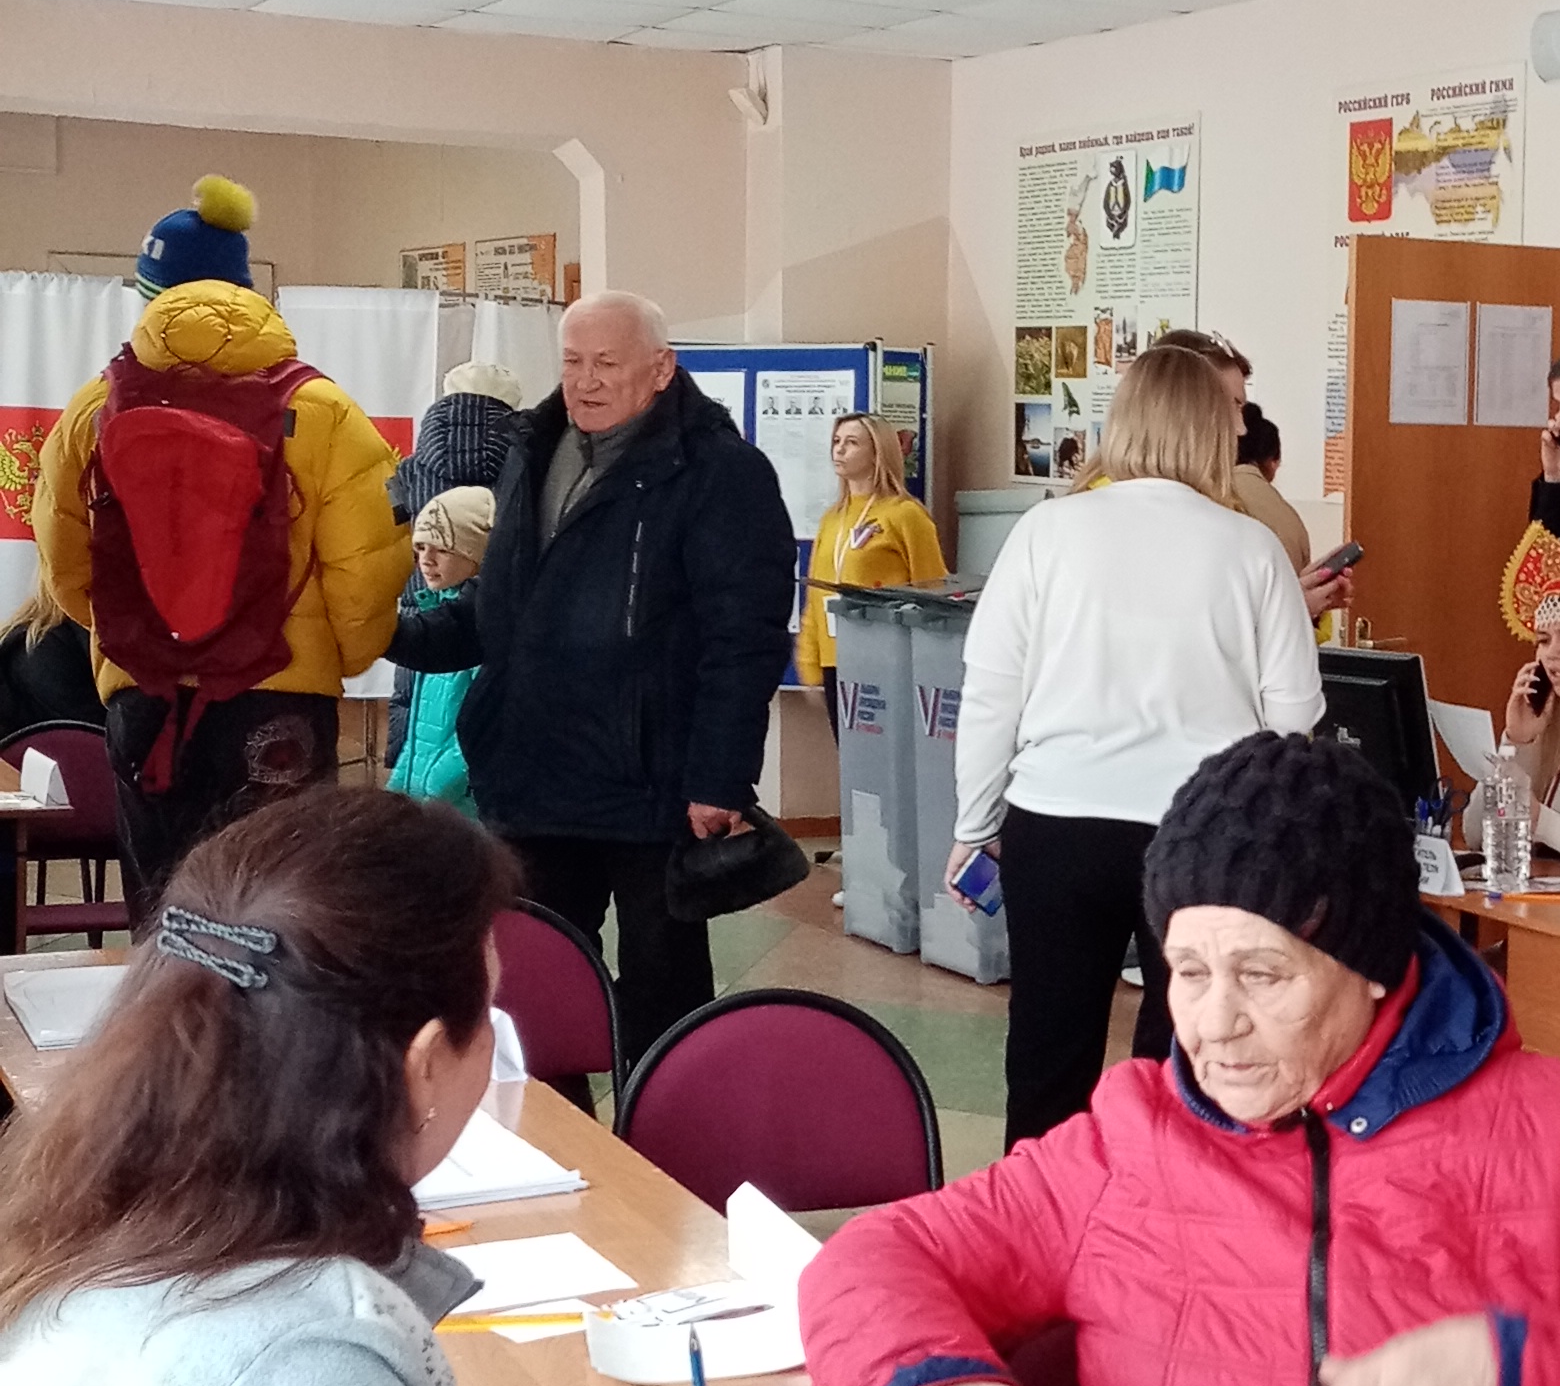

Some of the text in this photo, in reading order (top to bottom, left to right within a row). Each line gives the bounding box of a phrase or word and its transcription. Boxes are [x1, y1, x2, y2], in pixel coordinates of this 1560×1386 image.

[1431, 77, 1515, 102] РОССИЙСКИЙ ГИМН
[1338, 94, 1389, 114] РОССИЙСКИЙ
[1390, 92, 1411, 108] ГЕРБ
